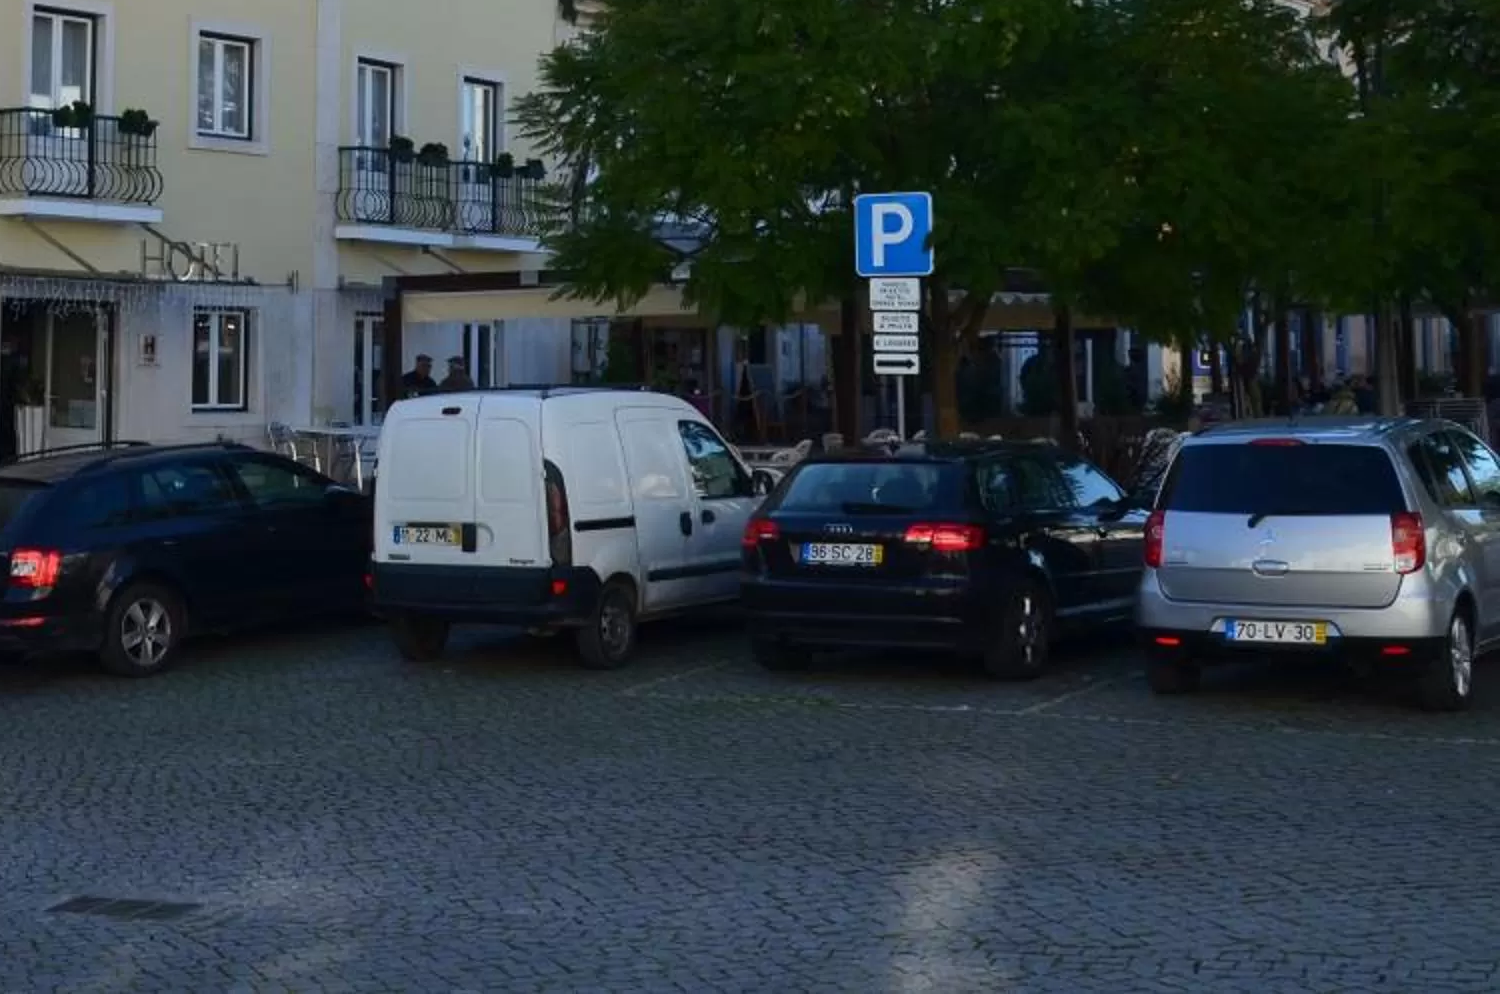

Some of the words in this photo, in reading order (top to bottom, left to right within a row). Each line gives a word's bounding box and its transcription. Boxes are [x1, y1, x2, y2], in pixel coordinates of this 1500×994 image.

[872, 203, 913, 267] P
[140, 239, 240, 282] HOTEL
[143, 335, 156, 355] H
